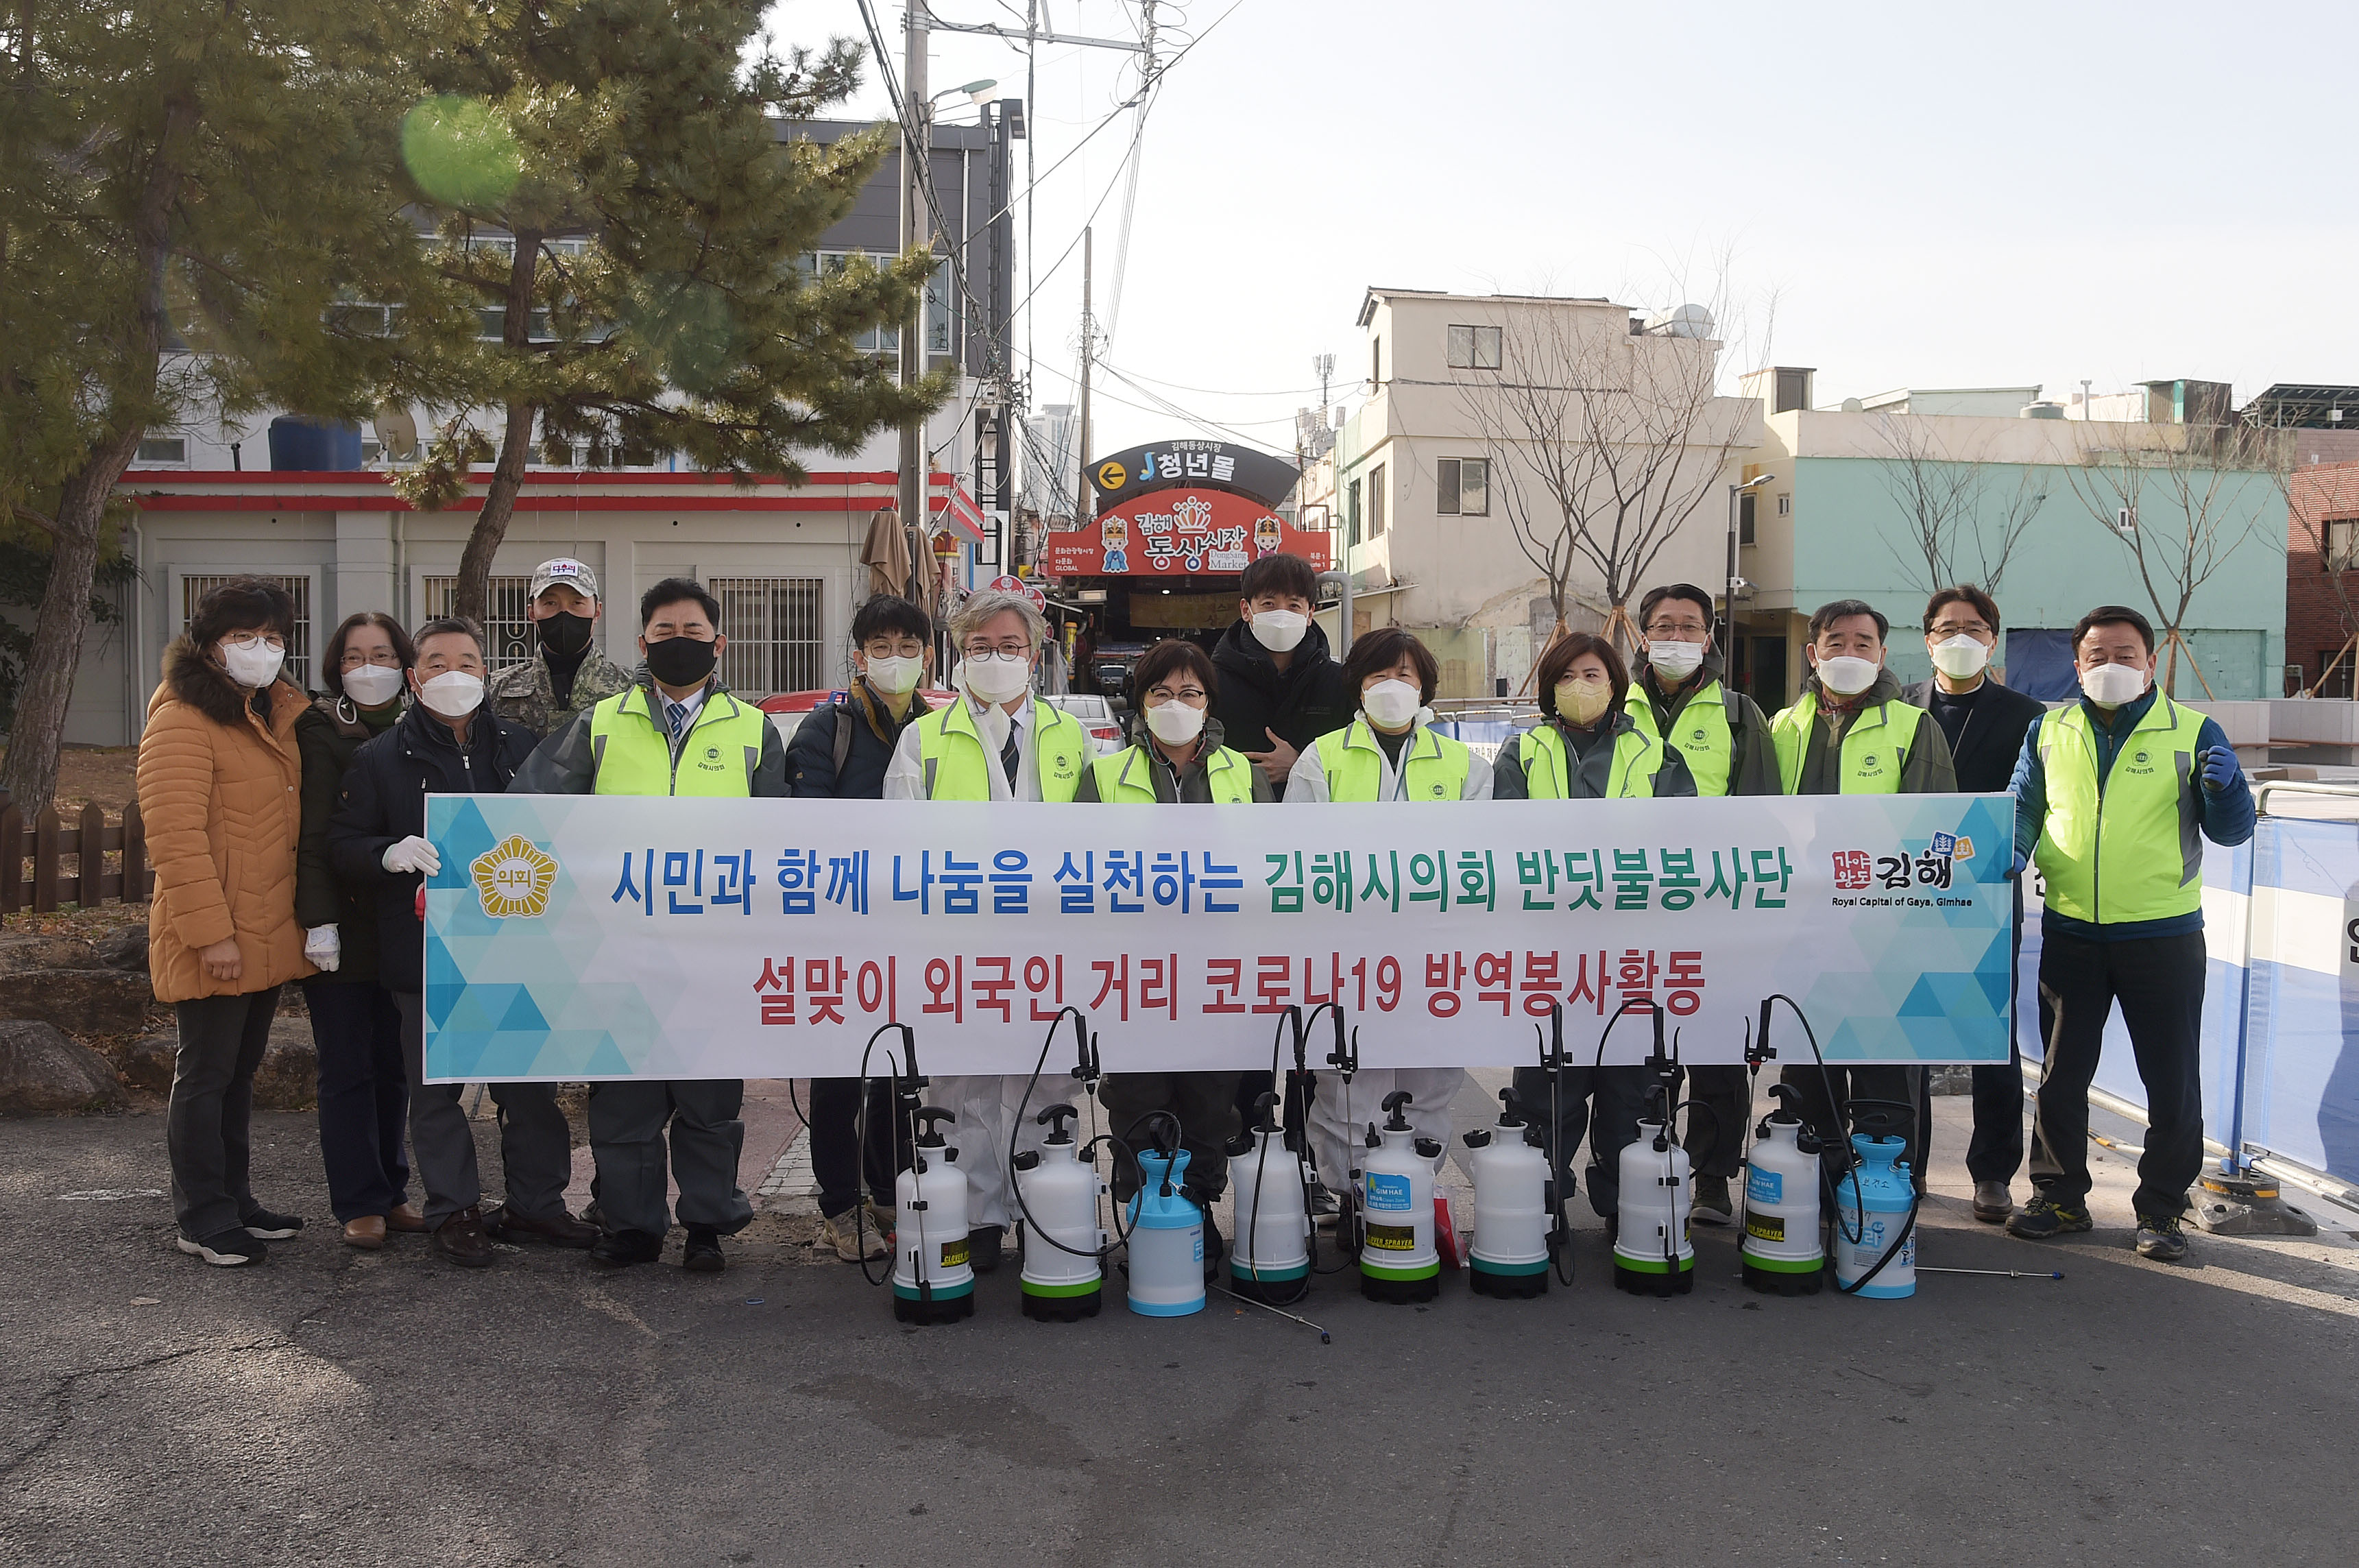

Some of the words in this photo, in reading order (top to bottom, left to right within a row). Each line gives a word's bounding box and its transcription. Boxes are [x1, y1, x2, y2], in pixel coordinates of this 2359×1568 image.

[1171, 441, 1222, 453] 김해동상시장
[1157, 453, 1235, 481] 청년몰
[1135, 514, 1172, 535] 김해
[1211, 550, 1246, 559] DongSang
[1211, 560, 1248, 569] Market
[697, 762, 725, 771] 김해시의회
[496, 869, 532, 889] 의회
[1876, 849, 1952, 890] 김해
[612, 848, 756, 916] 시민과
[777, 848, 869, 915] 함께
[893, 849, 1033, 915] 나눔을
[1053, 850, 1244, 914] 실천하는
[1265, 849, 1496, 914] 김해시의회
[1516, 845, 1793, 912] 반딧불봉사단
[1832, 897, 1856, 908] Royal
[1859, 897, 1892, 908] Capital
[1895, 897, 1904, 906] of
[1907, 897, 1933, 908] Gaya,
[1937, 897, 1972, 906] Gimhae
[753, 955, 897, 1026] 설맞이
[922, 953, 1063, 1025] 외국인
[1089, 953, 1178, 1022] 거리
[1202, 951, 1403, 1020] 코로나19
[1425, 948, 1706, 1019] 방역봉사활동
